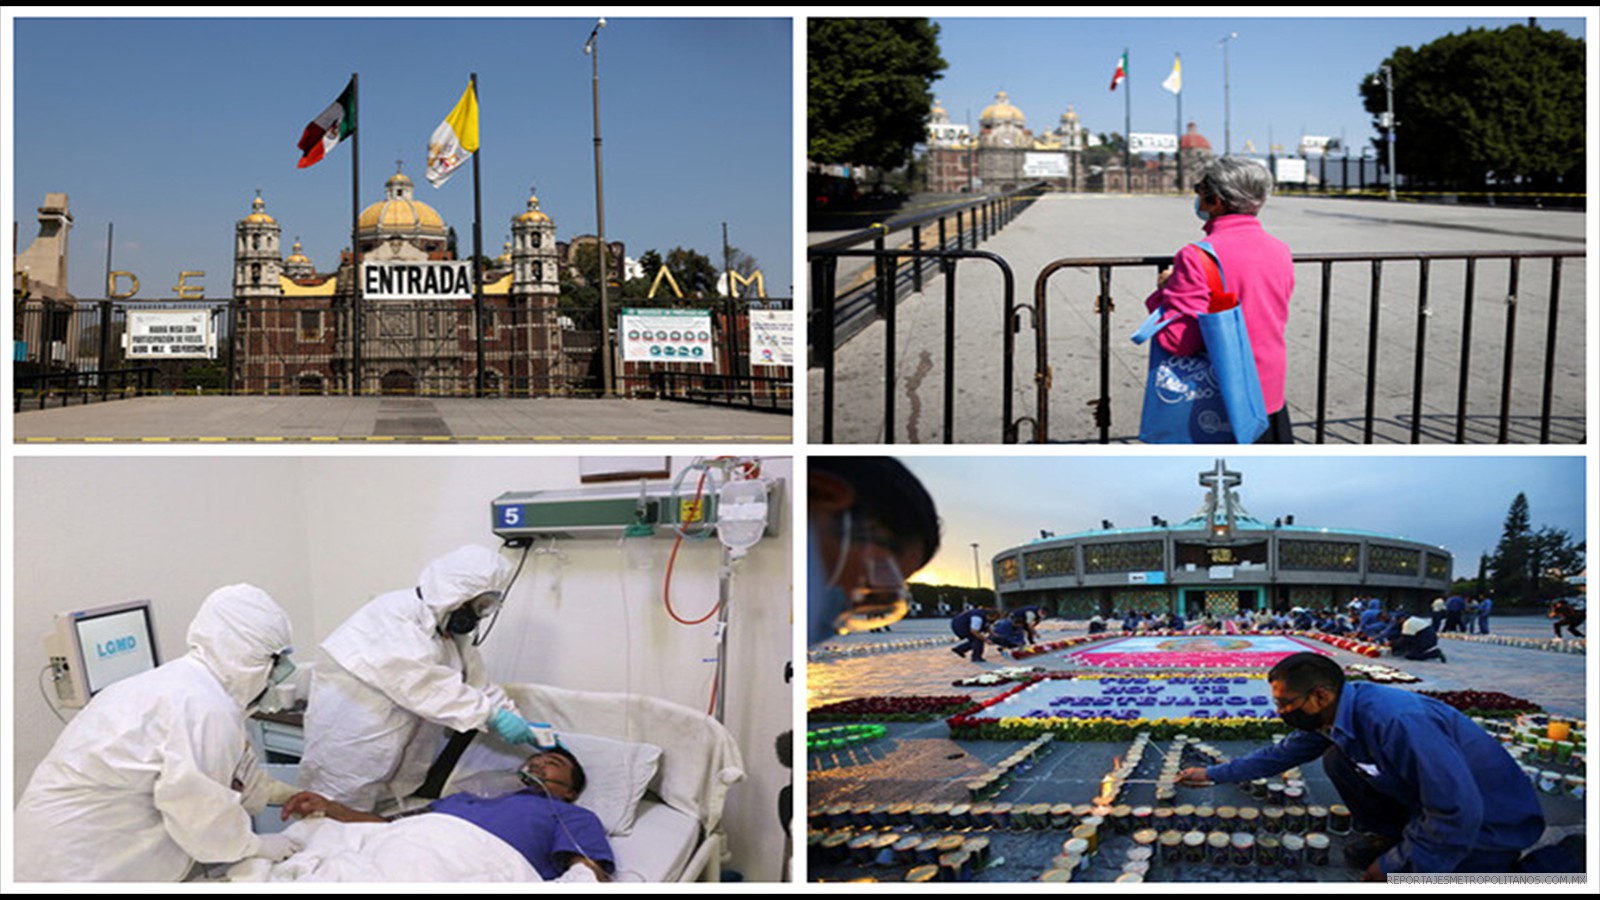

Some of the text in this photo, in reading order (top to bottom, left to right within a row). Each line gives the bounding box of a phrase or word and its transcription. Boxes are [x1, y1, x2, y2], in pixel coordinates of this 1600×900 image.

[1129, 135, 1175, 149] ENTRADA
[365, 265, 470, 294] ENTRADA
[504, 507, 519, 525] 5
[1102, 685, 1230, 694] HOY TE
[1049, 696, 1269, 707] FESTEJAMOS
